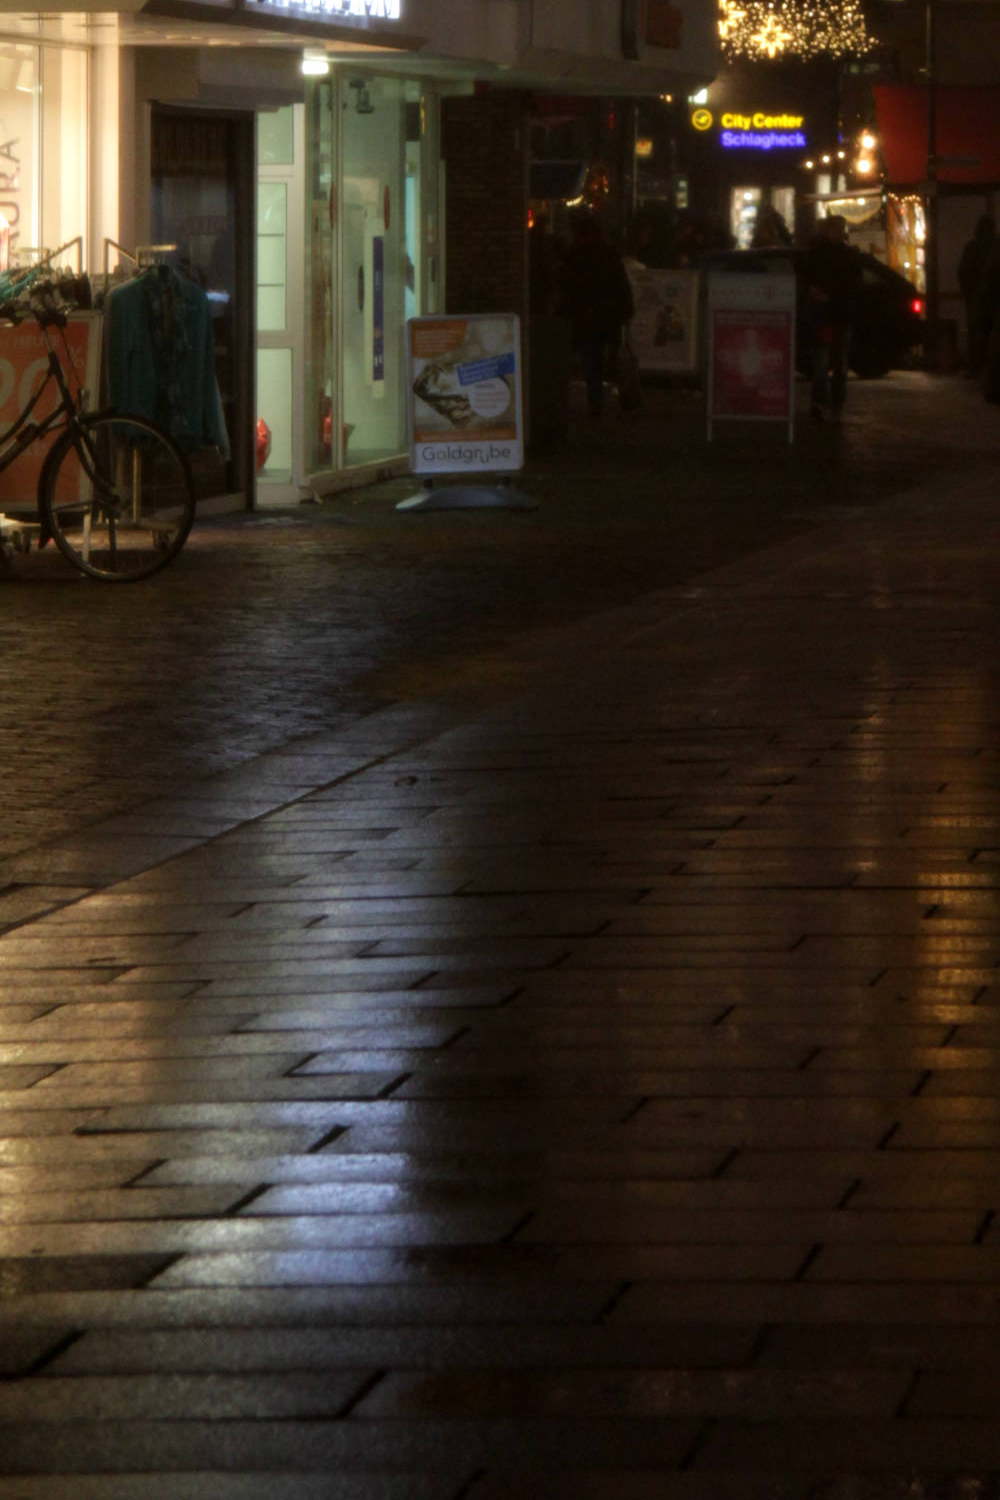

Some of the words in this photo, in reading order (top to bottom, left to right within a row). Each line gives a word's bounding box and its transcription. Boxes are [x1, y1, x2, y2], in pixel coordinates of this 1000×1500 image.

[721, 112, 751, 130] City
[752, 111, 804, 129] Center
[721, 131, 806, 150] Schlagheck
